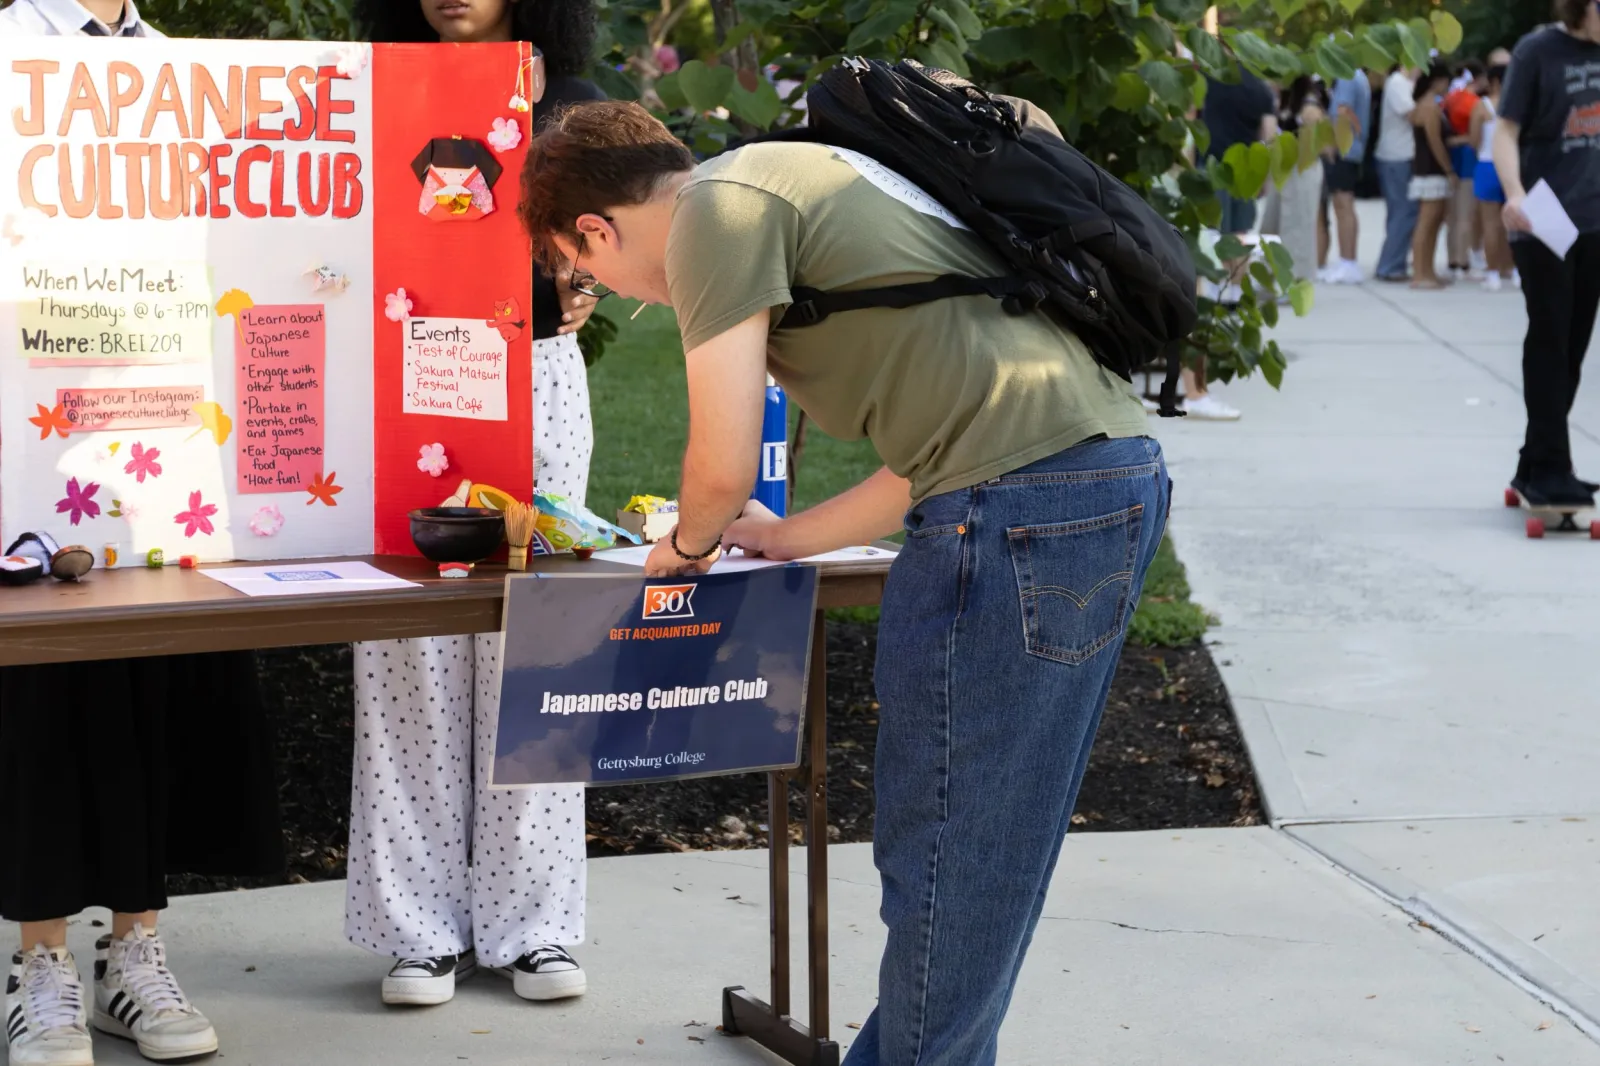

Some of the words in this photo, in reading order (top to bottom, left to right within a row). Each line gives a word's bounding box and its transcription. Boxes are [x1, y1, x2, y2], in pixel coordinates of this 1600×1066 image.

[12, 60, 355, 143] JAPANESE
[852, 153, 899, 188] NVEST
[904, 190, 918, 200] IN
[23, 267, 78, 290] When
[38, 297, 126, 327] Thursdays
[134, 302, 148, 318] @
[154, 302, 209, 319] 6-7PM
[248, 312, 287, 326] Learn
[290, 310, 323, 324] about
[21, 328, 95, 354] Where:
[246, 329, 310, 348] Japanese
[411, 320, 471, 343] Events
[251, 347, 290, 359] Culture
[415, 344, 443, 357] Test
[446, 345, 458, 360] of
[460, 346, 503, 367] Courage
[248, 364, 289, 384] Engage
[292, 364, 316, 375] with
[415, 360, 454, 378] Sakura
[459, 366, 501, 380] Matsuri
[247, 381, 274, 392] other
[280, 378, 319, 391] students
[416, 378, 459, 392] Festival
[103, 395, 126, 405] our
[130, 390, 200, 408] Instagram:
[248, 396, 292, 414] Partake
[296, 401, 307, 412] in
[412, 391, 453, 410] Sakura
[246, 415, 287, 428] events,
[247, 428, 266, 439] and
[272, 427, 305, 443] games
[247, 445, 267, 457] Eat
[271, 444, 323, 461] Japanese
[252, 458, 276, 470] food
[248, 473, 274, 486] Have
[276, 470, 301, 485] fun!
[651, 590, 684, 613] 30
[609, 628, 631, 640] GET
[632, 624, 700, 641] ACQUAINTED
[701, 621, 722, 636] DAY
[540, 691, 643, 715] Japanese
[647, 685, 720, 710] Culture
[724, 678, 768, 703] Club
[597, 755, 662, 771] Gettysburg
[664, 751, 706, 765] College
